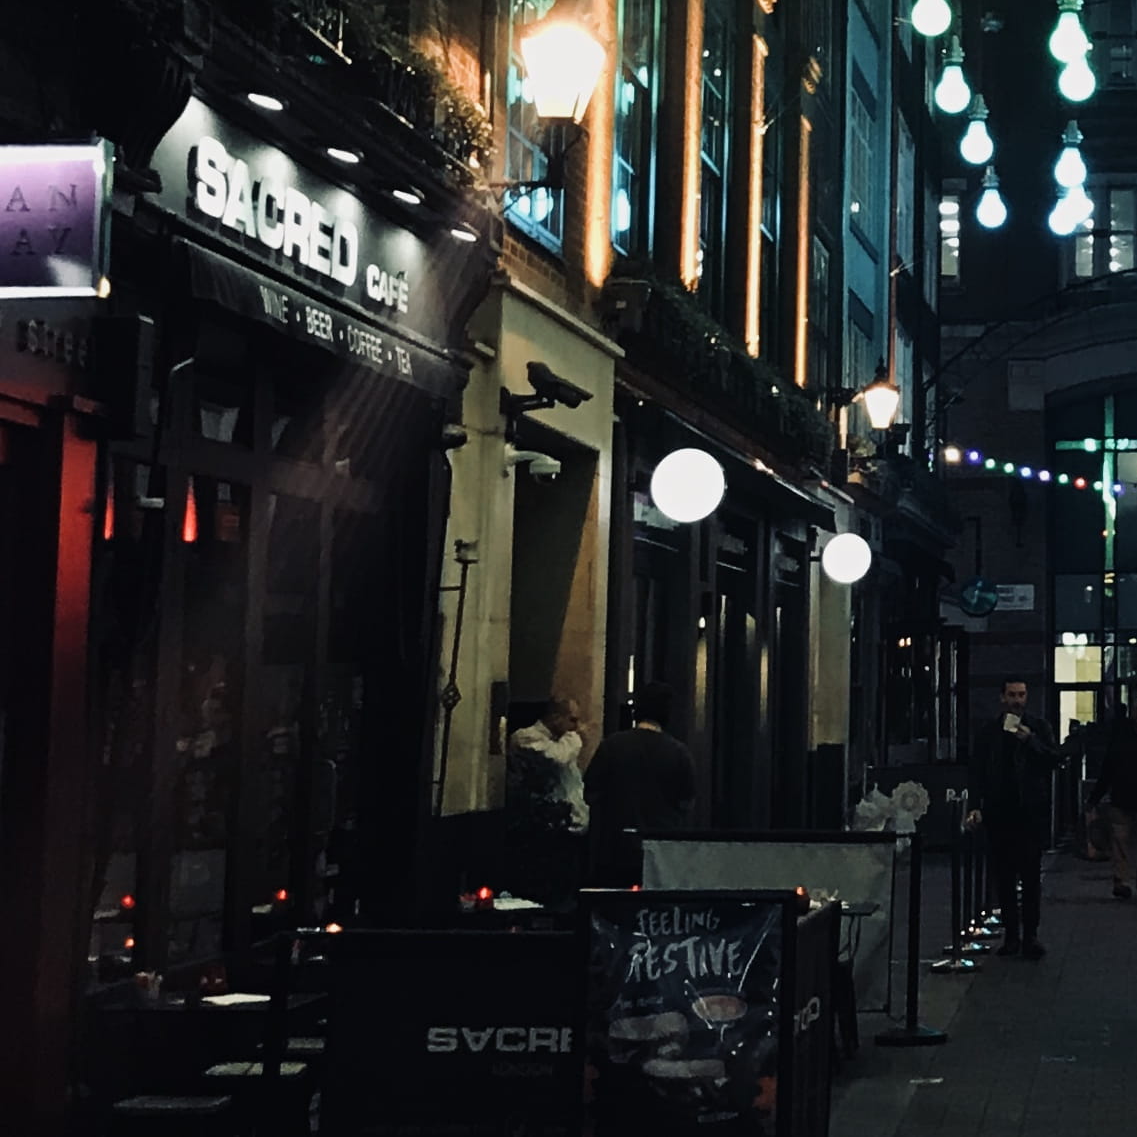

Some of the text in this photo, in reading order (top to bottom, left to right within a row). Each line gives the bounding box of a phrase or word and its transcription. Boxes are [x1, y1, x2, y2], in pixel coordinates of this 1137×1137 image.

[196, 135, 358, 287] SACRED
[259, 285, 413, 376] WINE BEER COFFEE TEA
[635, 906, 720, 936] FEELING
[625, 936, 744, 984] FESTIVE
